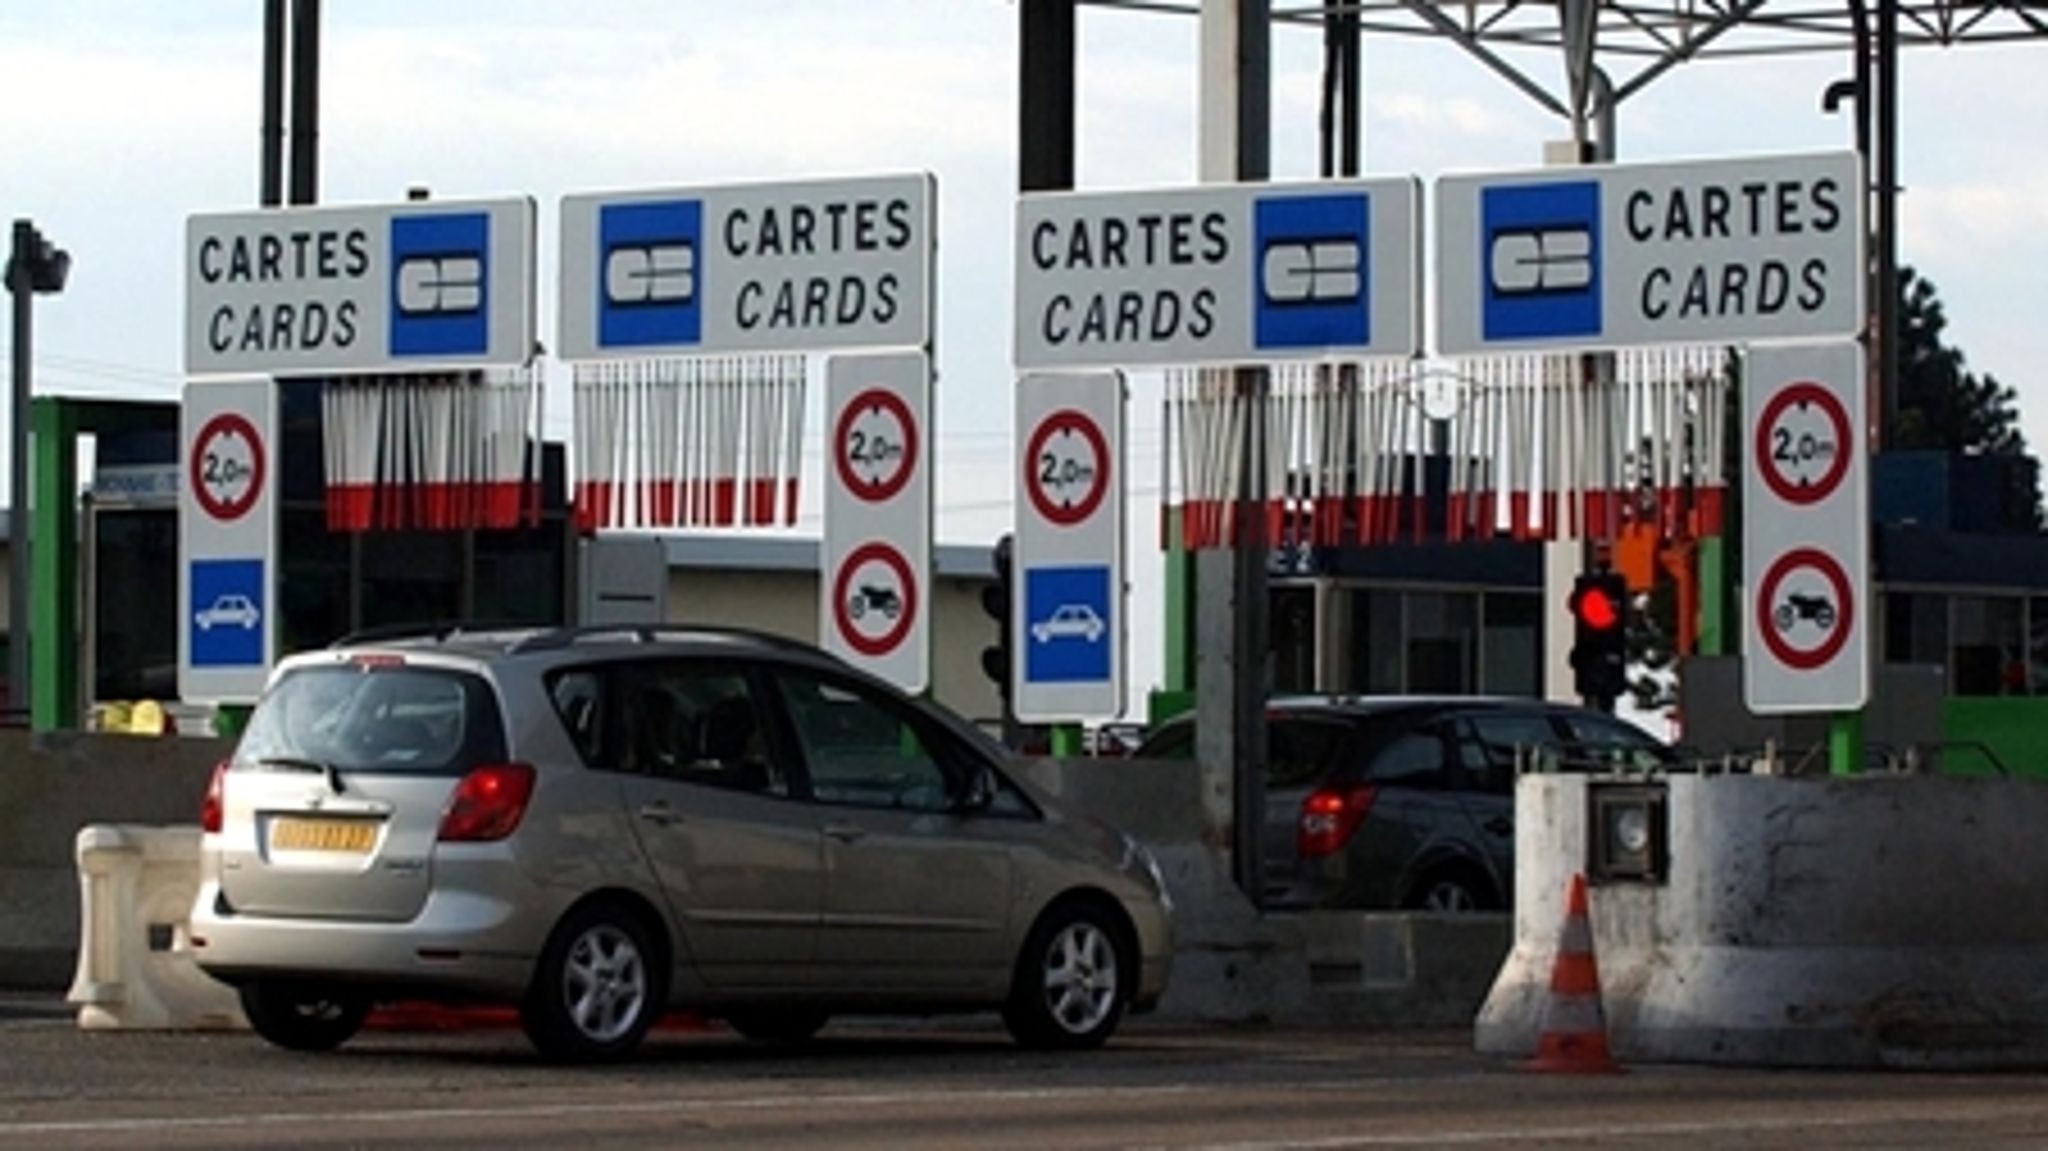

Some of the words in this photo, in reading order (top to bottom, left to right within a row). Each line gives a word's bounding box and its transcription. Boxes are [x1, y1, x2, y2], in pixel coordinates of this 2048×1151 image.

[724, 198, 912, 257] CARTES
[1625, 177, 1842, 243] CARTES
[199, 229, 370, 284] CARTES
[1032, 212, 1230, 271] CARTES
[736, 273, 900, 331] CARDS
[1043, 287, 1217, 346] CARDS
[1641, 258, 1828, 321] CARDS
[208, 298, 358, 353] CARDS
